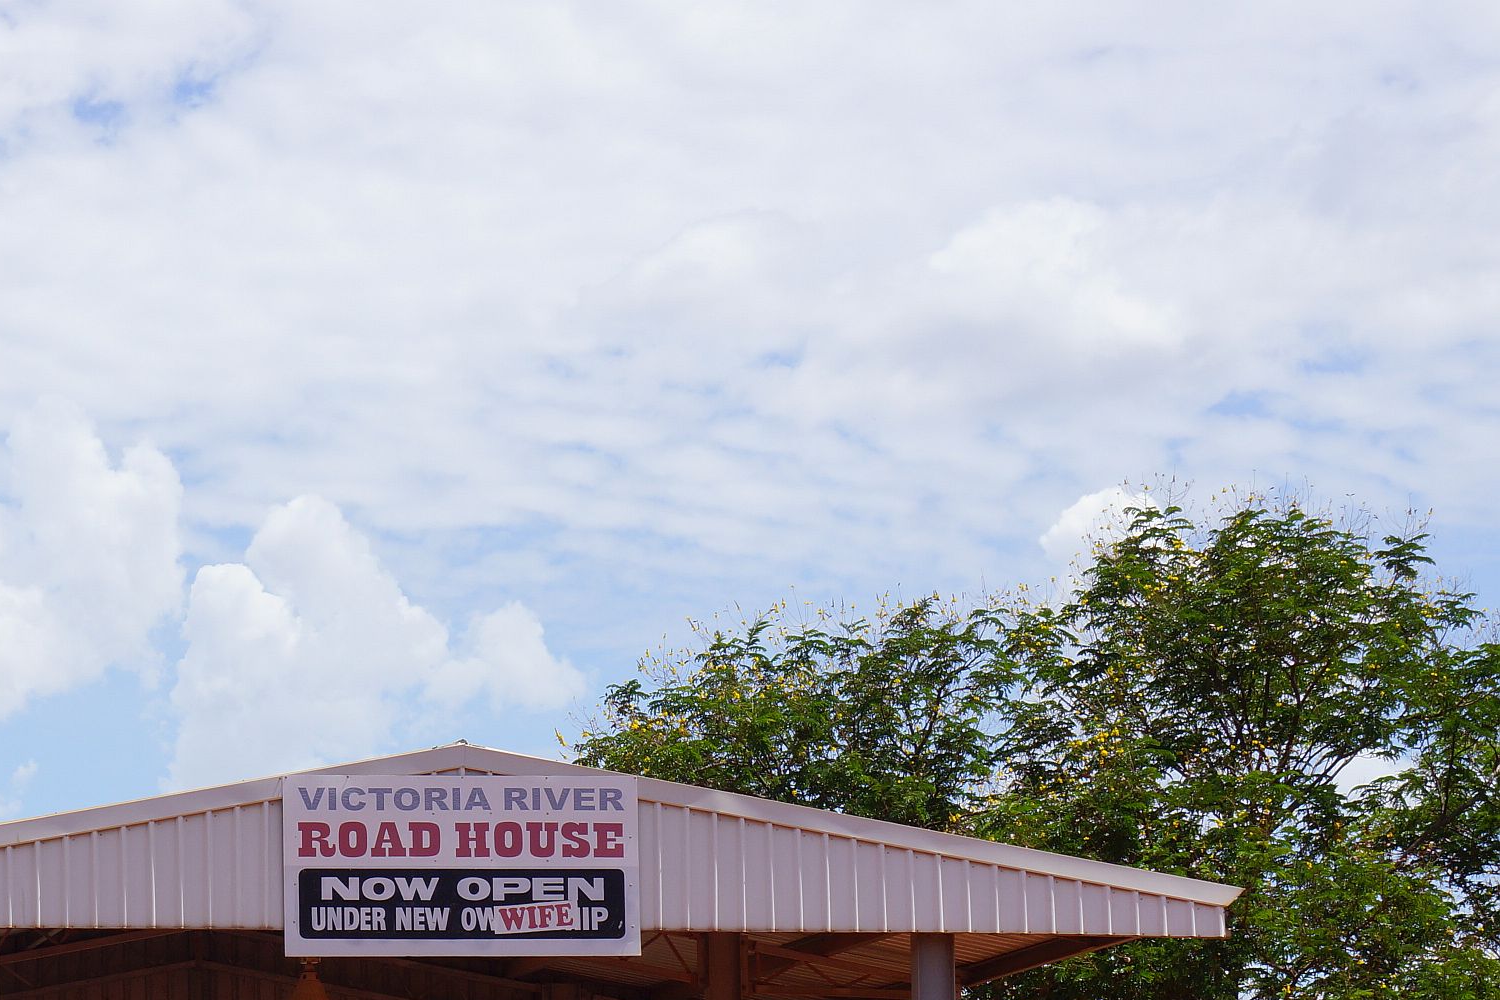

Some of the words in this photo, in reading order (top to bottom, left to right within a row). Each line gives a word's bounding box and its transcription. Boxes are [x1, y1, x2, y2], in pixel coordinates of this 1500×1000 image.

[298, 787, 492, 811] VICTORIA
[504, 788, 625, 811] RIVER
[297, 821, 442, 858] ROAD
[454, 822, 625, 858] HOUSE
[320, 876, 440, 900] NOW
[456, 877, 605, 901] OPEN
[311, 907, 387, 931] UNDER
[396, 907, 450, 931] NEW
[499, 903, 573, 930] WIFE
